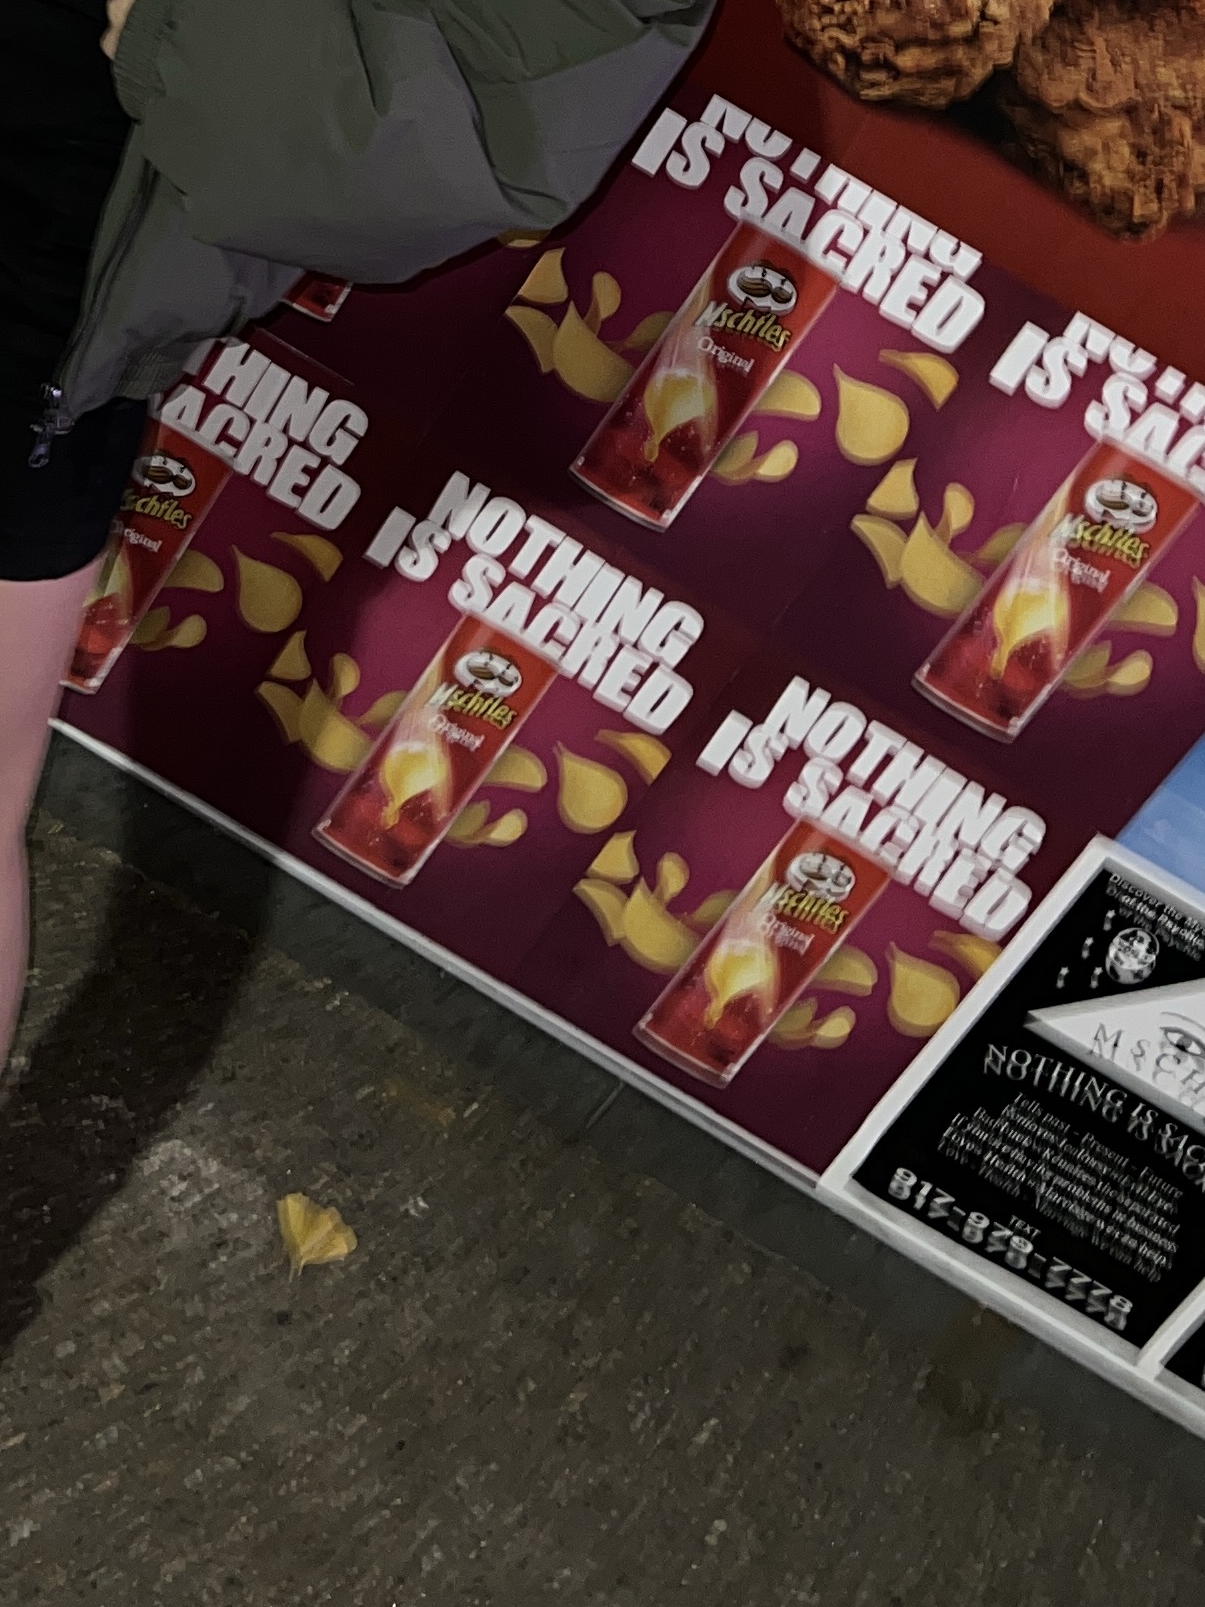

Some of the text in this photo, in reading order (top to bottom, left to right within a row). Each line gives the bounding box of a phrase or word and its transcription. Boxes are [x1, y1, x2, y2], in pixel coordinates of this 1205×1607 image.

[631, 107, 725, 190] IS
[723, 156, 986, 354] SACRED
[698, 336, 754, 376] Original
[989, 320, 1088, 410] IS
[150, 384, 361, 530] ACRED
[362, 506, 693, 736] IS SACRED
[428, 470, 704, 668] NOTHING
[695, 709, 1032, 942] IS SACRED
[764, 675, 1046, 874] NOTHING
[1108, 873, 1165, 908] Discover
[984, 1044, 1131, 1123] NOTHING
[1008, 1214, 1041, 1244] TEXT
